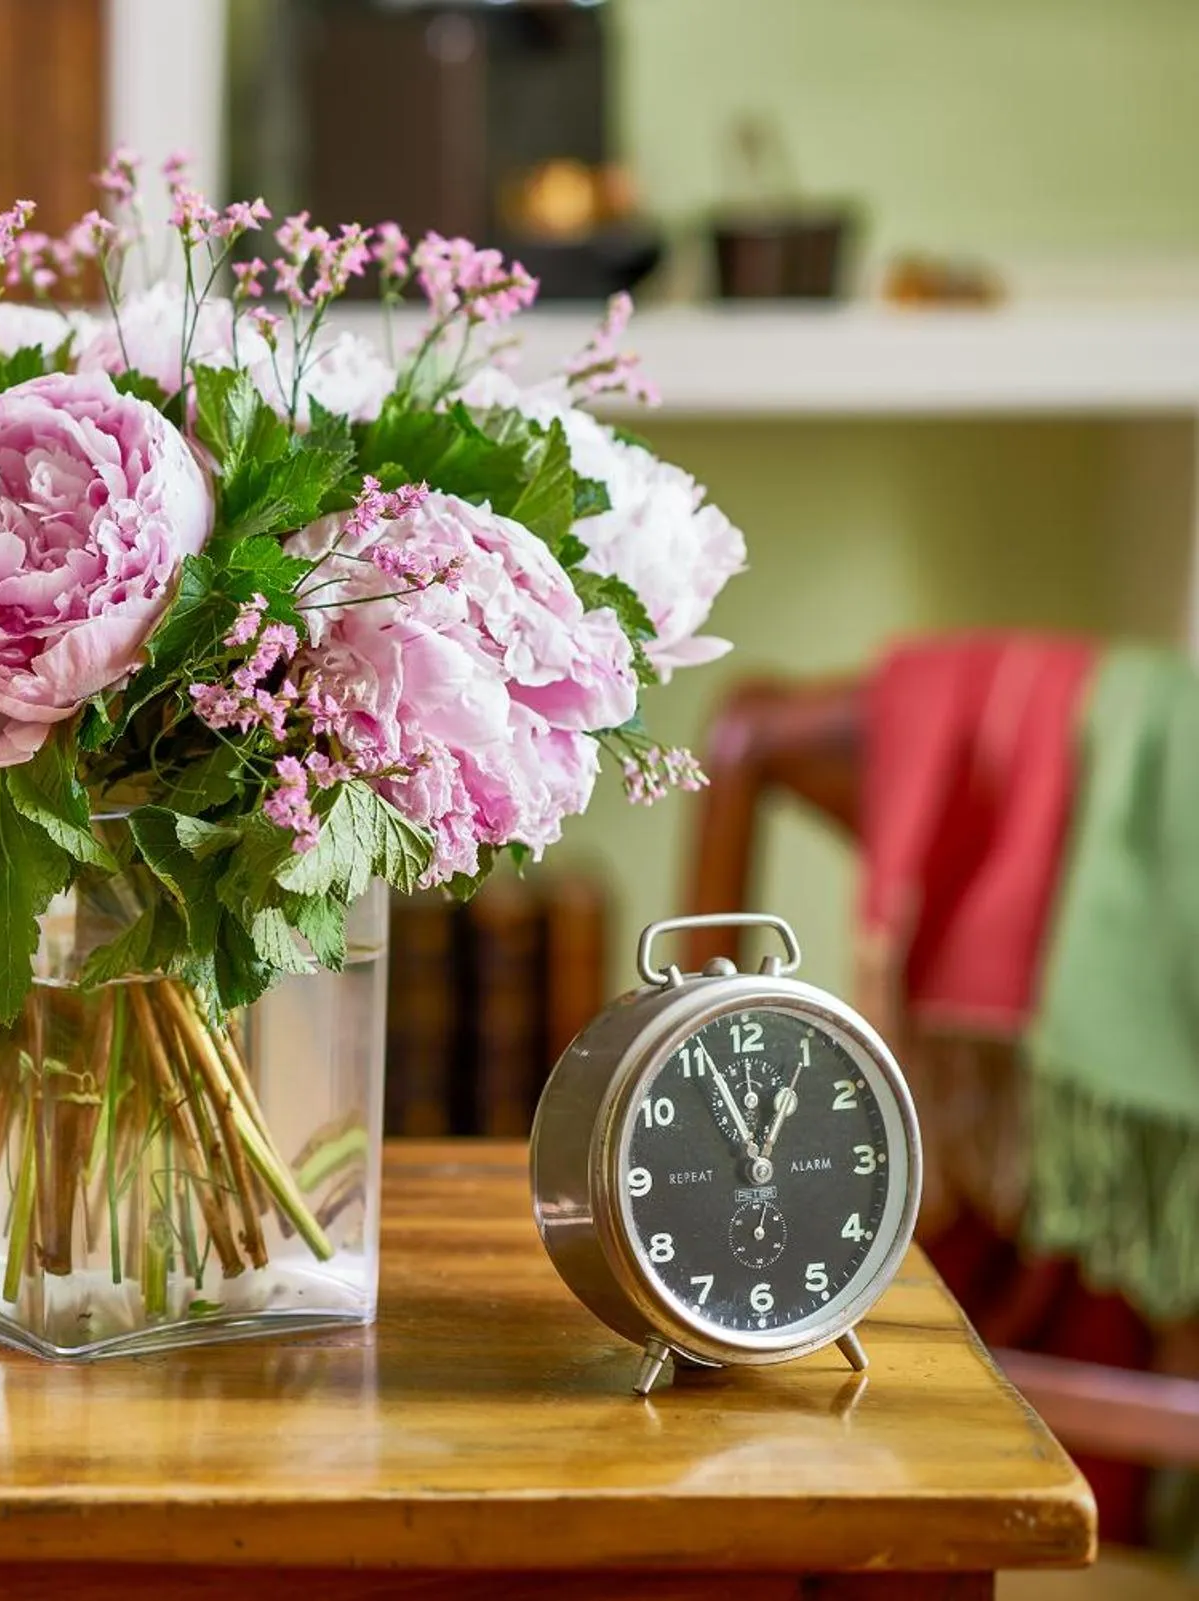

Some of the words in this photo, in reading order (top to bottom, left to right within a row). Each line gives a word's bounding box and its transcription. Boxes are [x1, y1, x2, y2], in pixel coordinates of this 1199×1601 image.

[730, 1023, 764, 1053] 12
[800, 1038, 811, 1067] 1
[679, 1047, 706, 1078] 11
[832, 1080, 857, 1110] 2
[640, 1097, 675, 1128] 10
[790, 1157, 832, 1174] ALARM
[853, 1145, 876, 1175] 3
[627, 1167, 652, 1197] 9
[669, 1169, 714, 1185] REPEAT
[841, 1213, 865, 1242] 4
[649, 1232, 675, 1263] 8
[690, 1274, 714, 1304] 7
[805, 1262, 829, 1292] 5
[750, 1283, 774, 1313] 6
